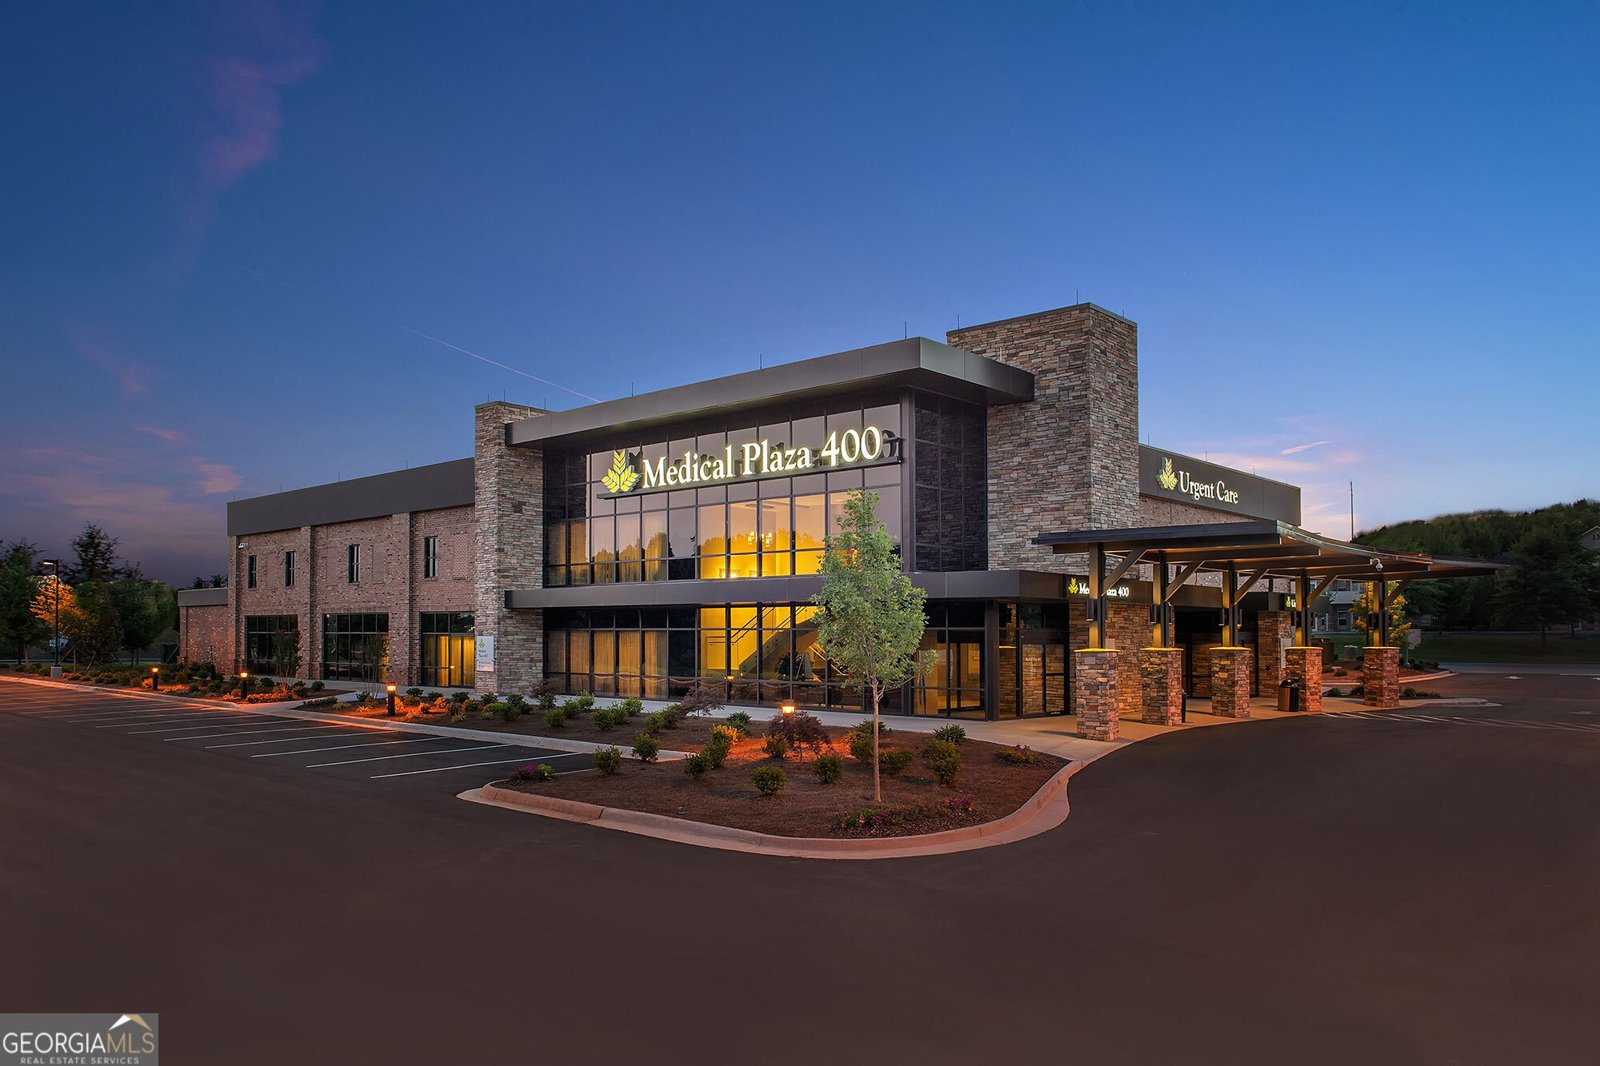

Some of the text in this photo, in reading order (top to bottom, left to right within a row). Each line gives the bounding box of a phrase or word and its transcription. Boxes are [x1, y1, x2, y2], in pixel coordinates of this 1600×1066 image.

[642, 425, 884, 489] Medical Plaza 400
[1179, 470, 1239, 504] Urgent Care
[1117, 586, 1130, 598] 400
